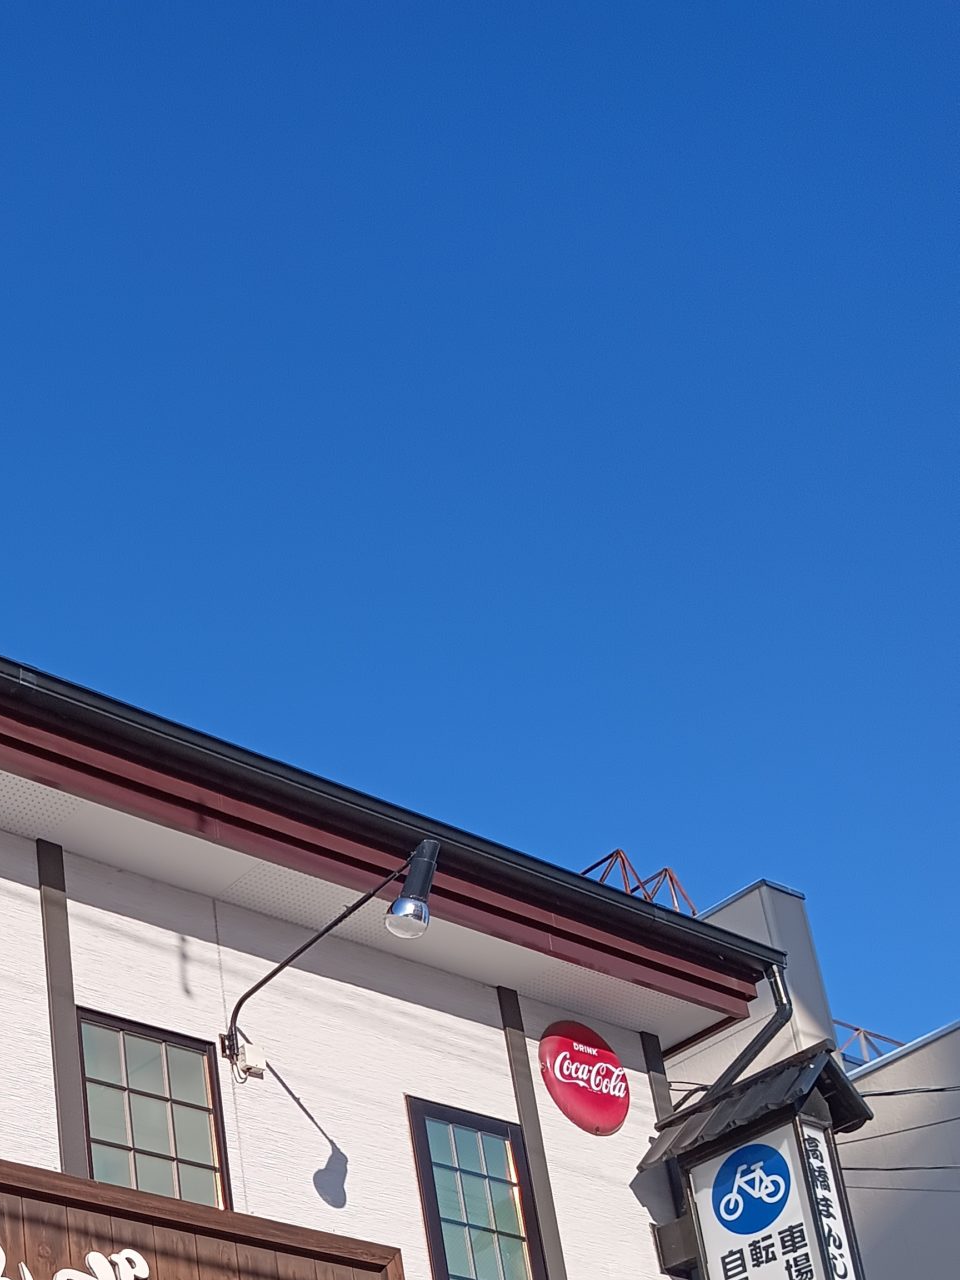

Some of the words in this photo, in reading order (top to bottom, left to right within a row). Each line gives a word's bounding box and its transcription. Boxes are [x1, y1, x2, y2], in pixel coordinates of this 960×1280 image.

[573, 1042, 598, 1056] DRINK
[554, 1051, 627, 1098] Coca-Cola
[721, 1222, 808, 1280] 自転車
